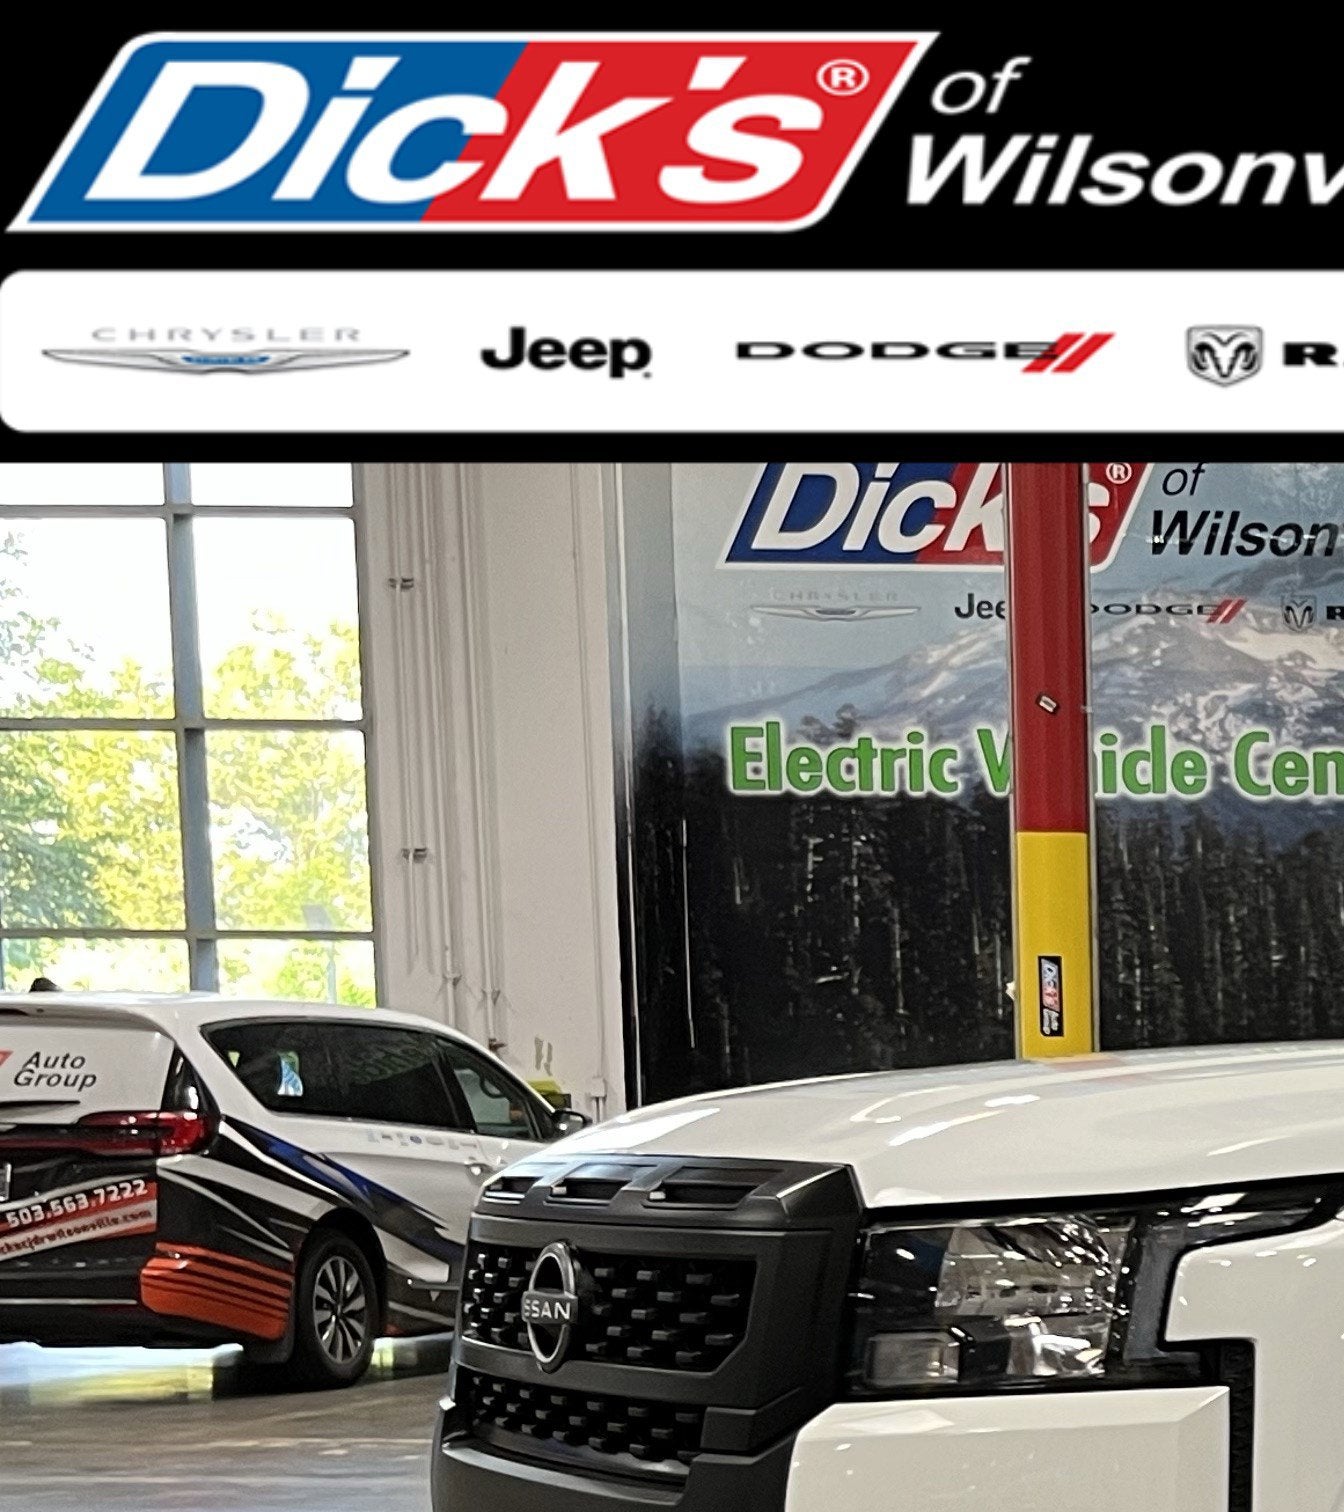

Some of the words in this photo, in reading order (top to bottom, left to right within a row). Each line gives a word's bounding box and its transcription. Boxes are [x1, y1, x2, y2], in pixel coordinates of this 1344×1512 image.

[1163, 462, 1204, 496] of
[954, 593, 1005, 620] Jee
[1090, 604, 1219, 616] ODGE
[731, 720, 960, 792] Electric
[976, 714, 1207, 794] Vicle
[22, 1051, 86, 1070] Auto
[14, 1069, 97, 1092] Group
[6, 1179, 148, 1228] 503.563.7222
